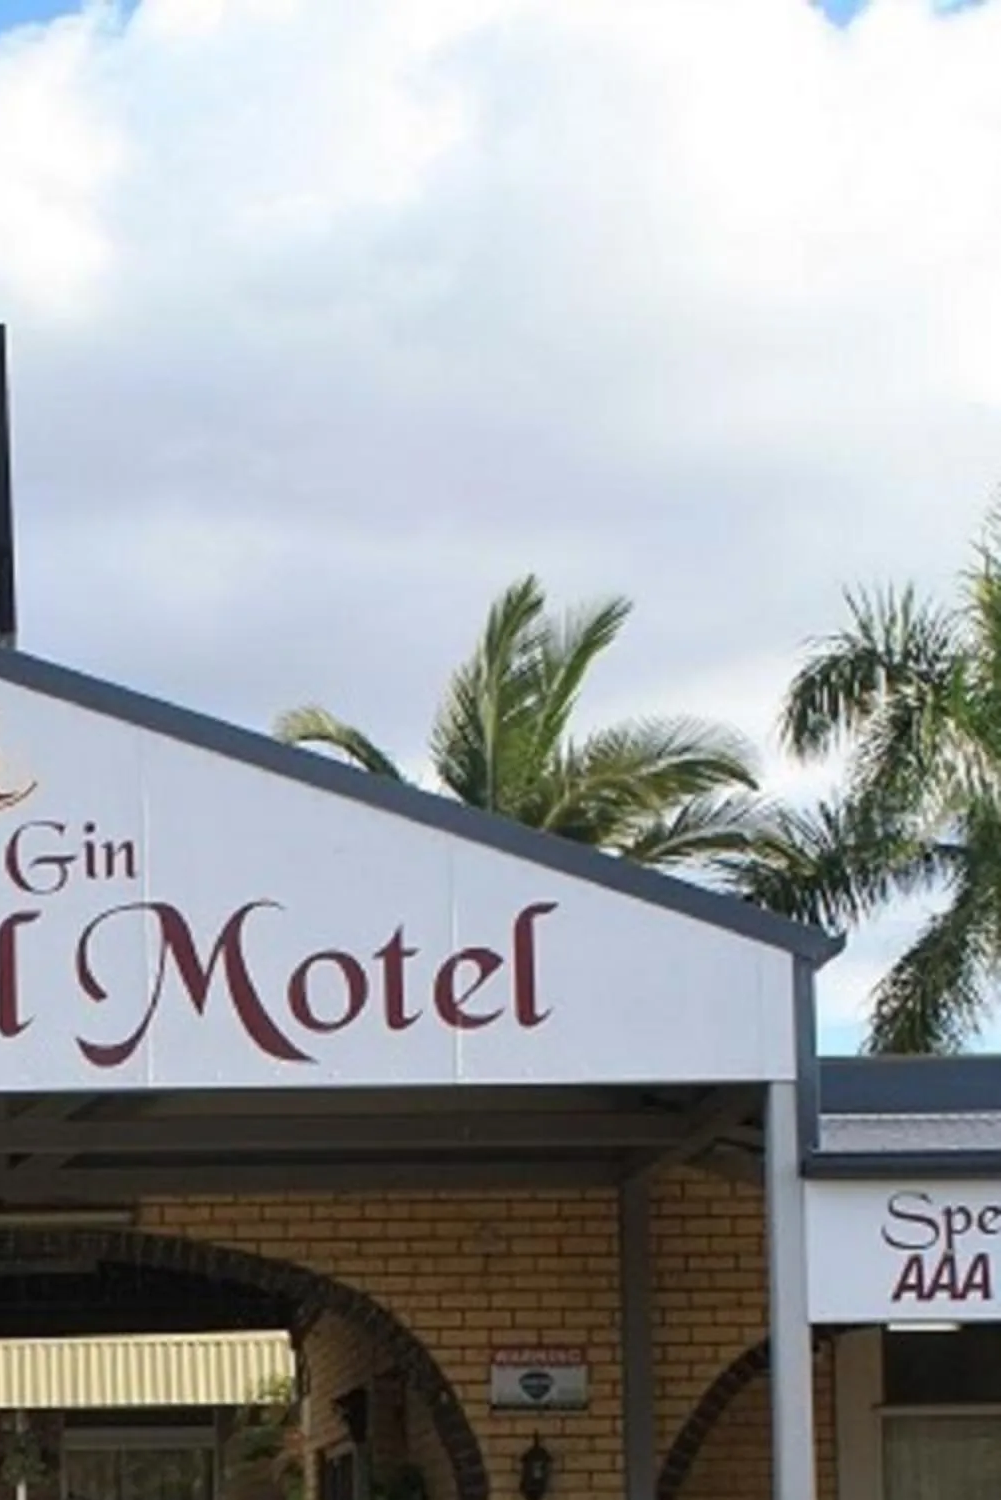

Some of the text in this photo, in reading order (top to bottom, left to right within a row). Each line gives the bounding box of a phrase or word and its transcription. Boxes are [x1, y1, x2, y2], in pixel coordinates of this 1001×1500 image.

[5, 820, 136, 895] Gin
[75, 897, 560, 1068] Motel
[890, 1252, 993, 1302] AAA
